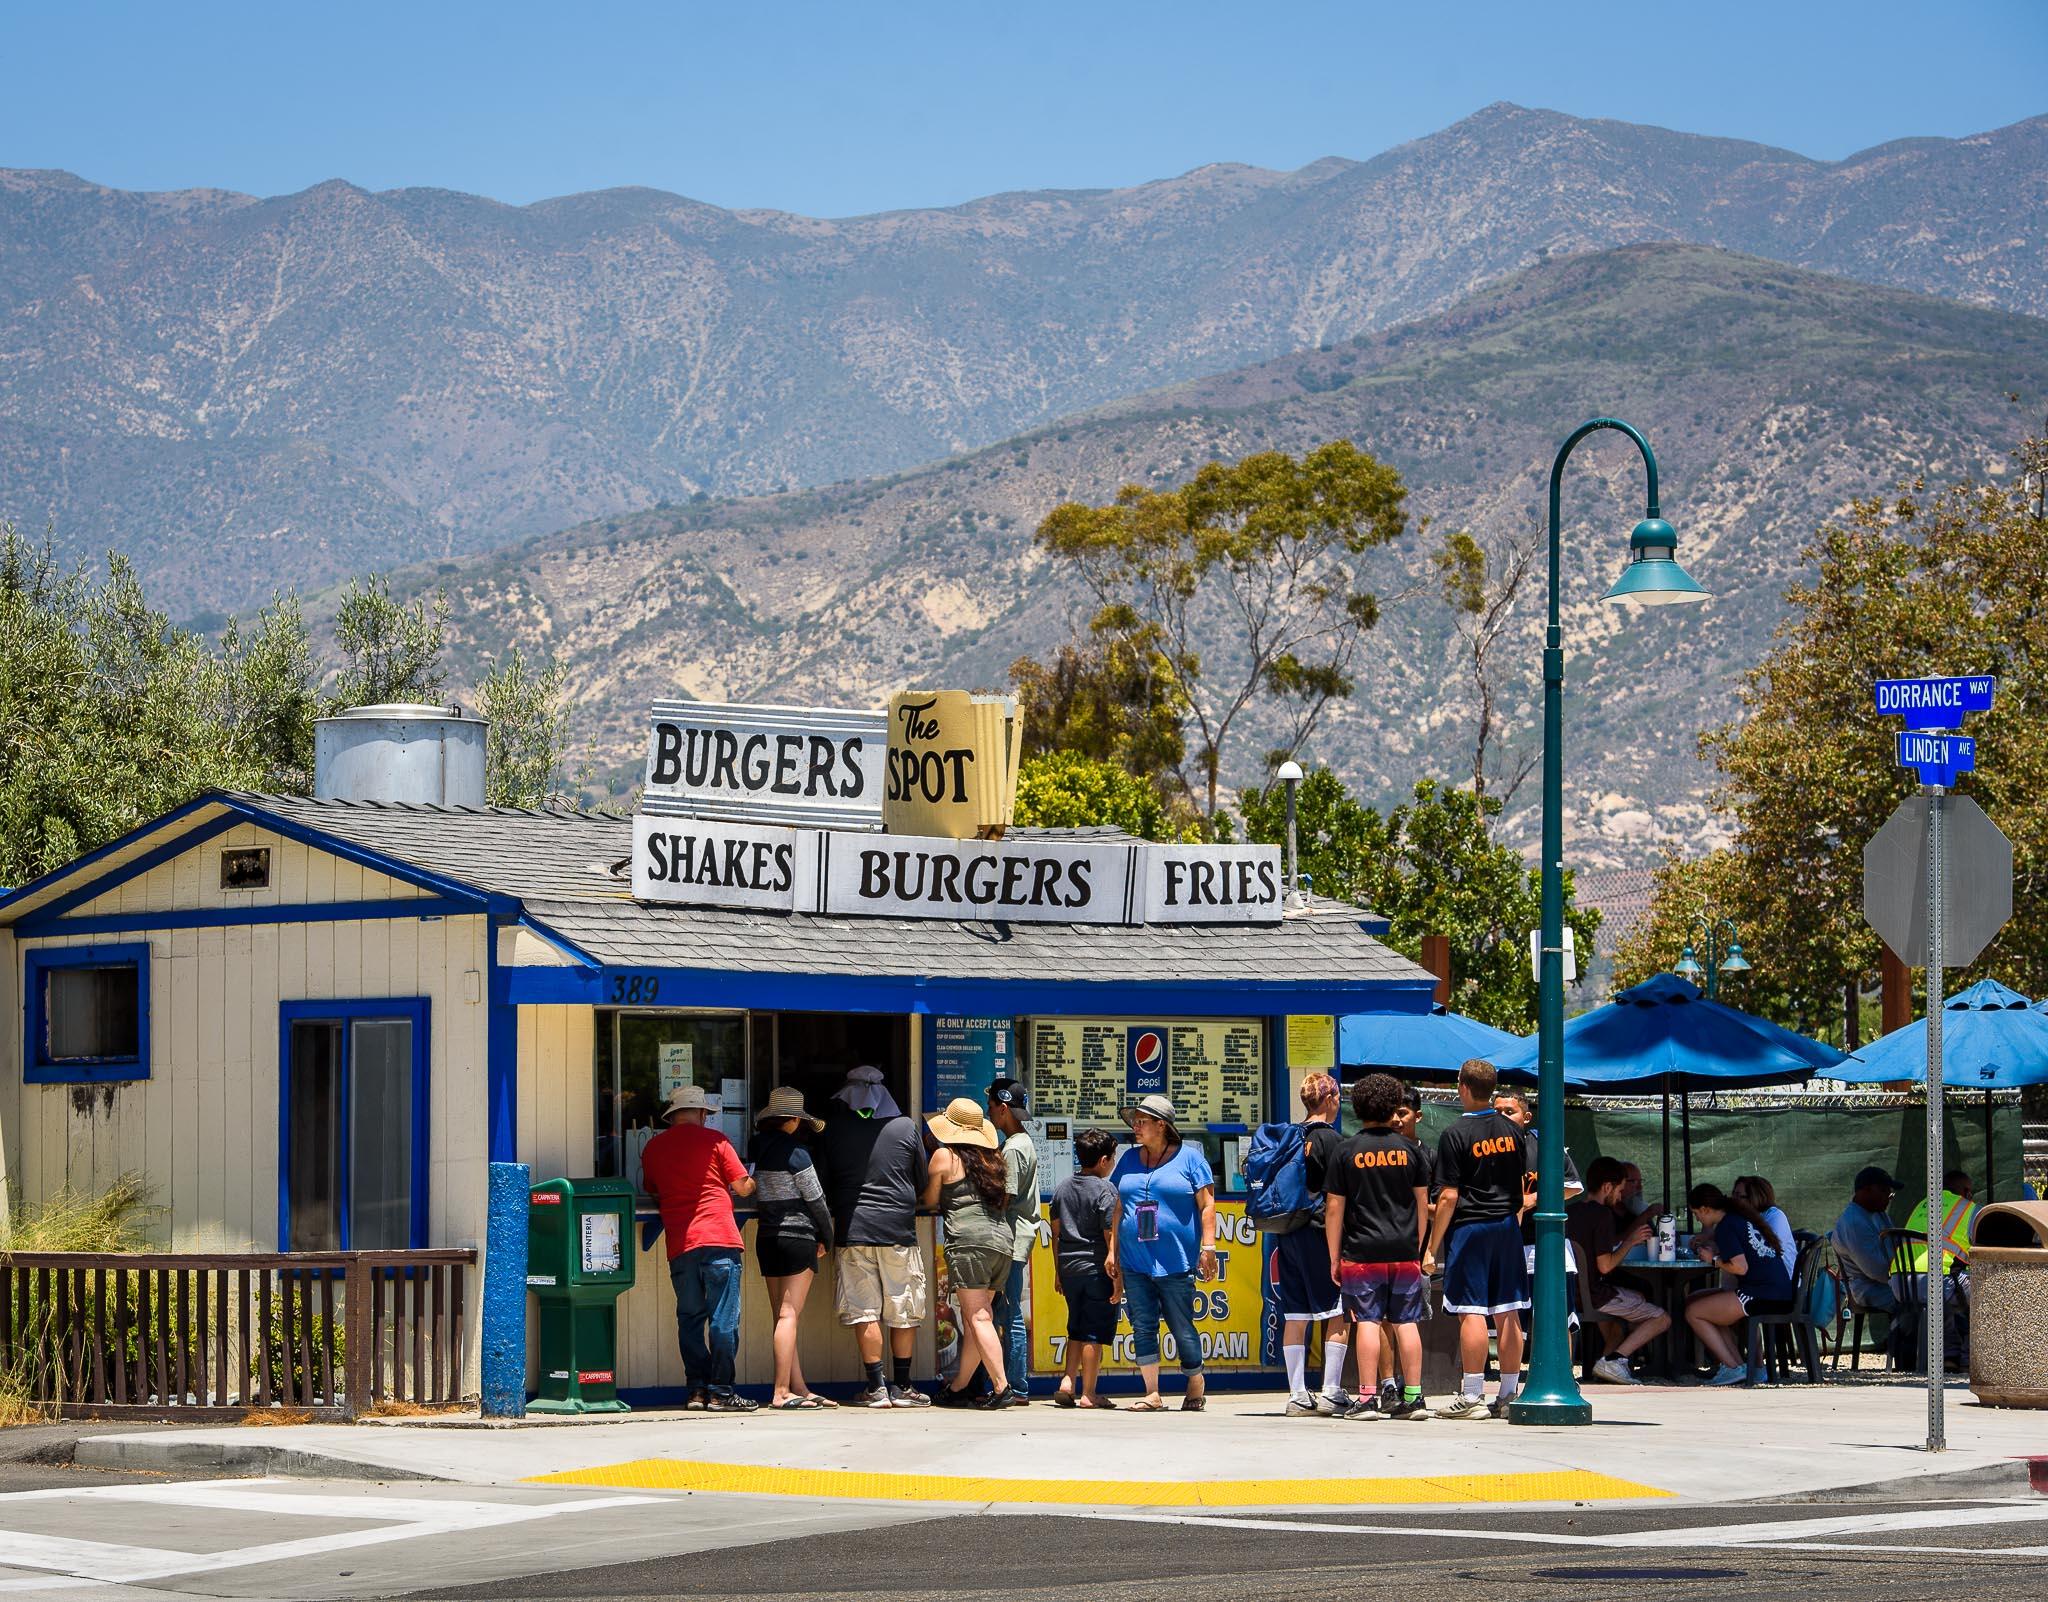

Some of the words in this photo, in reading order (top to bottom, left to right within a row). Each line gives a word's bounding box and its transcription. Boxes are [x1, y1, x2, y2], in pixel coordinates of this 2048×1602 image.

[1879, 683, 1962, 709] DORRANCE
[1969, 680, 1990, 694] WAY
[898, 698, 941, 742] The
[652, 722, 864, 799] BURGERS
[1905, 737, 1949, 765] LINDEN
[1958, 742, 1971, 756] AVE
[887, 748, 974, 803] SPOT
[647, 831, 794, 892] SHAKES
[859, 849, 1092, 908] BURGERS
[1164, 859, 1276, 906] FRIES
[612, 975, 659, 1003] 389
[947, 1019, 964, 1028] ONLY
[966, 1019, 991, 1029] ACCEPT
[992, 1019, 1011, 1029] CASH
[1137, 1077, 1160, 1088] pepsi
[1354, 1150, 1409, 1169] COACH
[1471, 1136, 1516, 1158] COACH
[585, 1216, 593, 1271] CARPINTERIA
[1264, 1297, 1280, 1359] pepsi
[585, 1372, 612, 1380] CARPINTERIA
